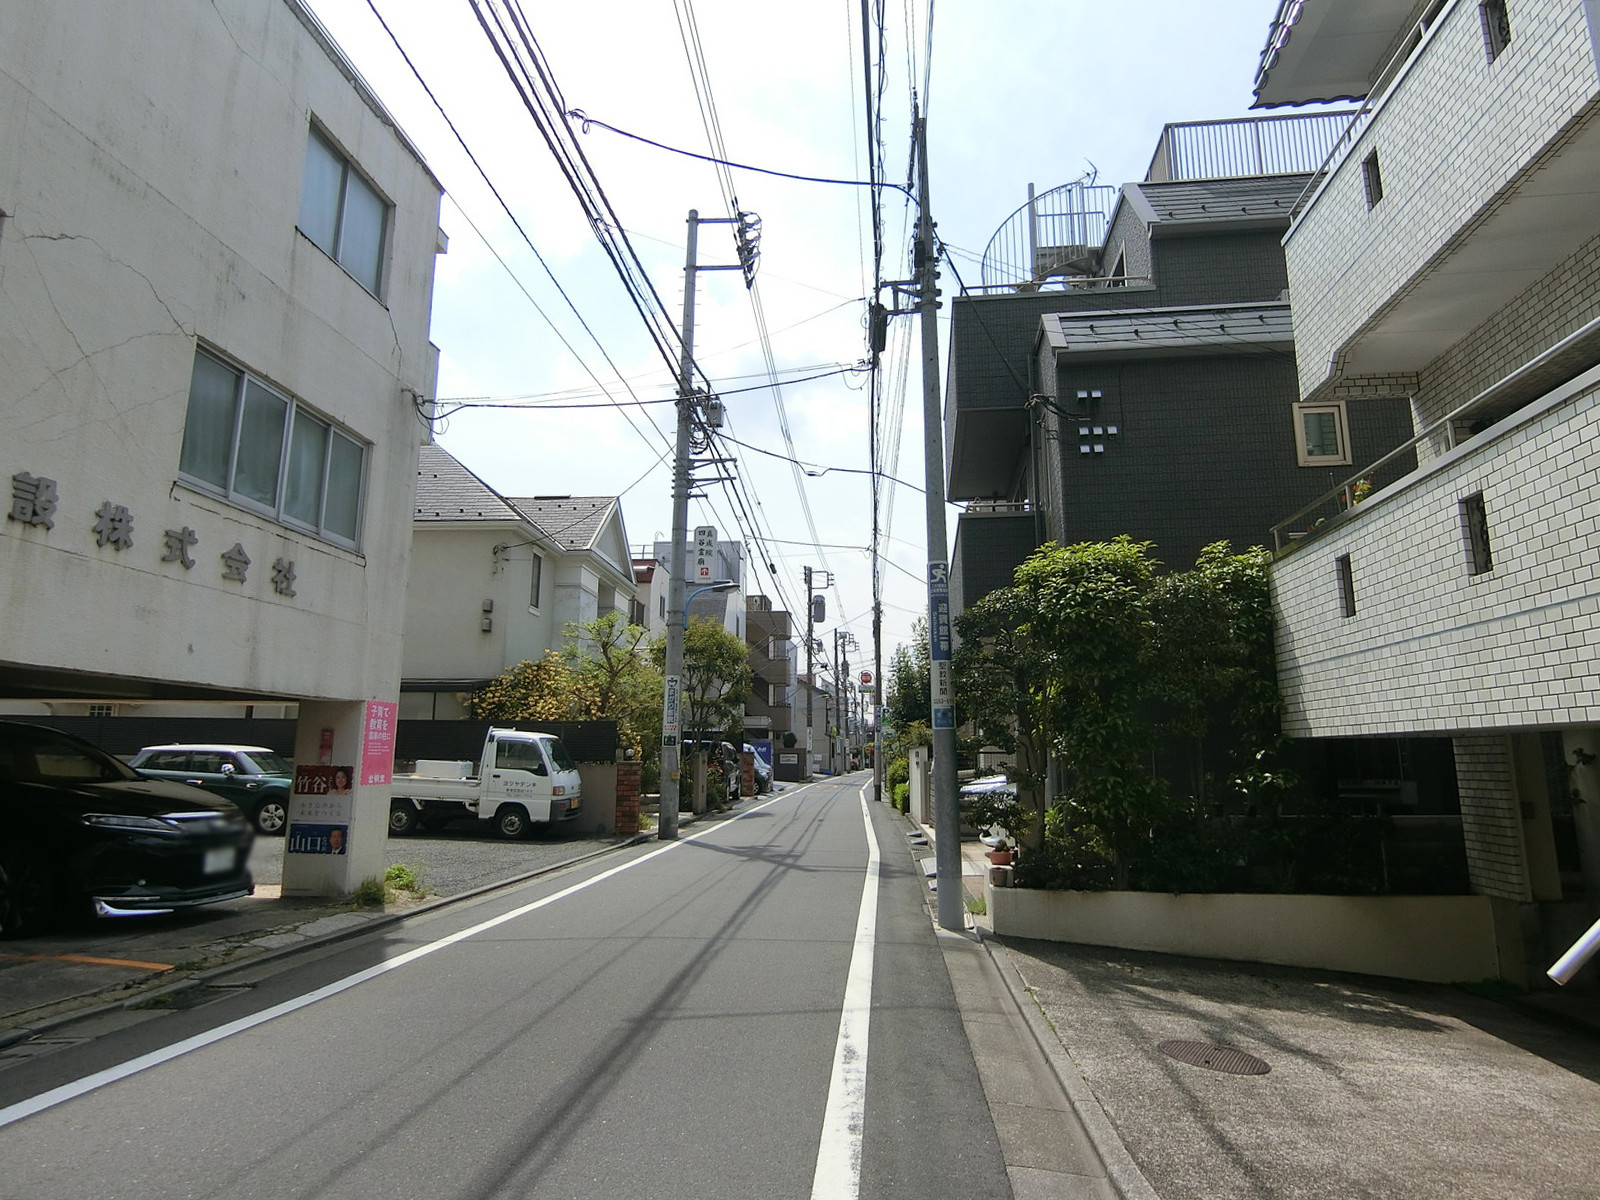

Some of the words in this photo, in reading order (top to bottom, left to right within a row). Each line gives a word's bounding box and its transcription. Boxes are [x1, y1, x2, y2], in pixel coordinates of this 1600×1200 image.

[8, 471, 297, 598] 設株式会社
[705, 529, 714, 557] 真成院
[938, 661, 948, 696] 聖教新聞
[369, 718, 388, 731] 教育を
[297, 776, 328, 793] 竹谷
[368, 774, 385, 784] 公明党
[290, 835, 321, 852] 山口
